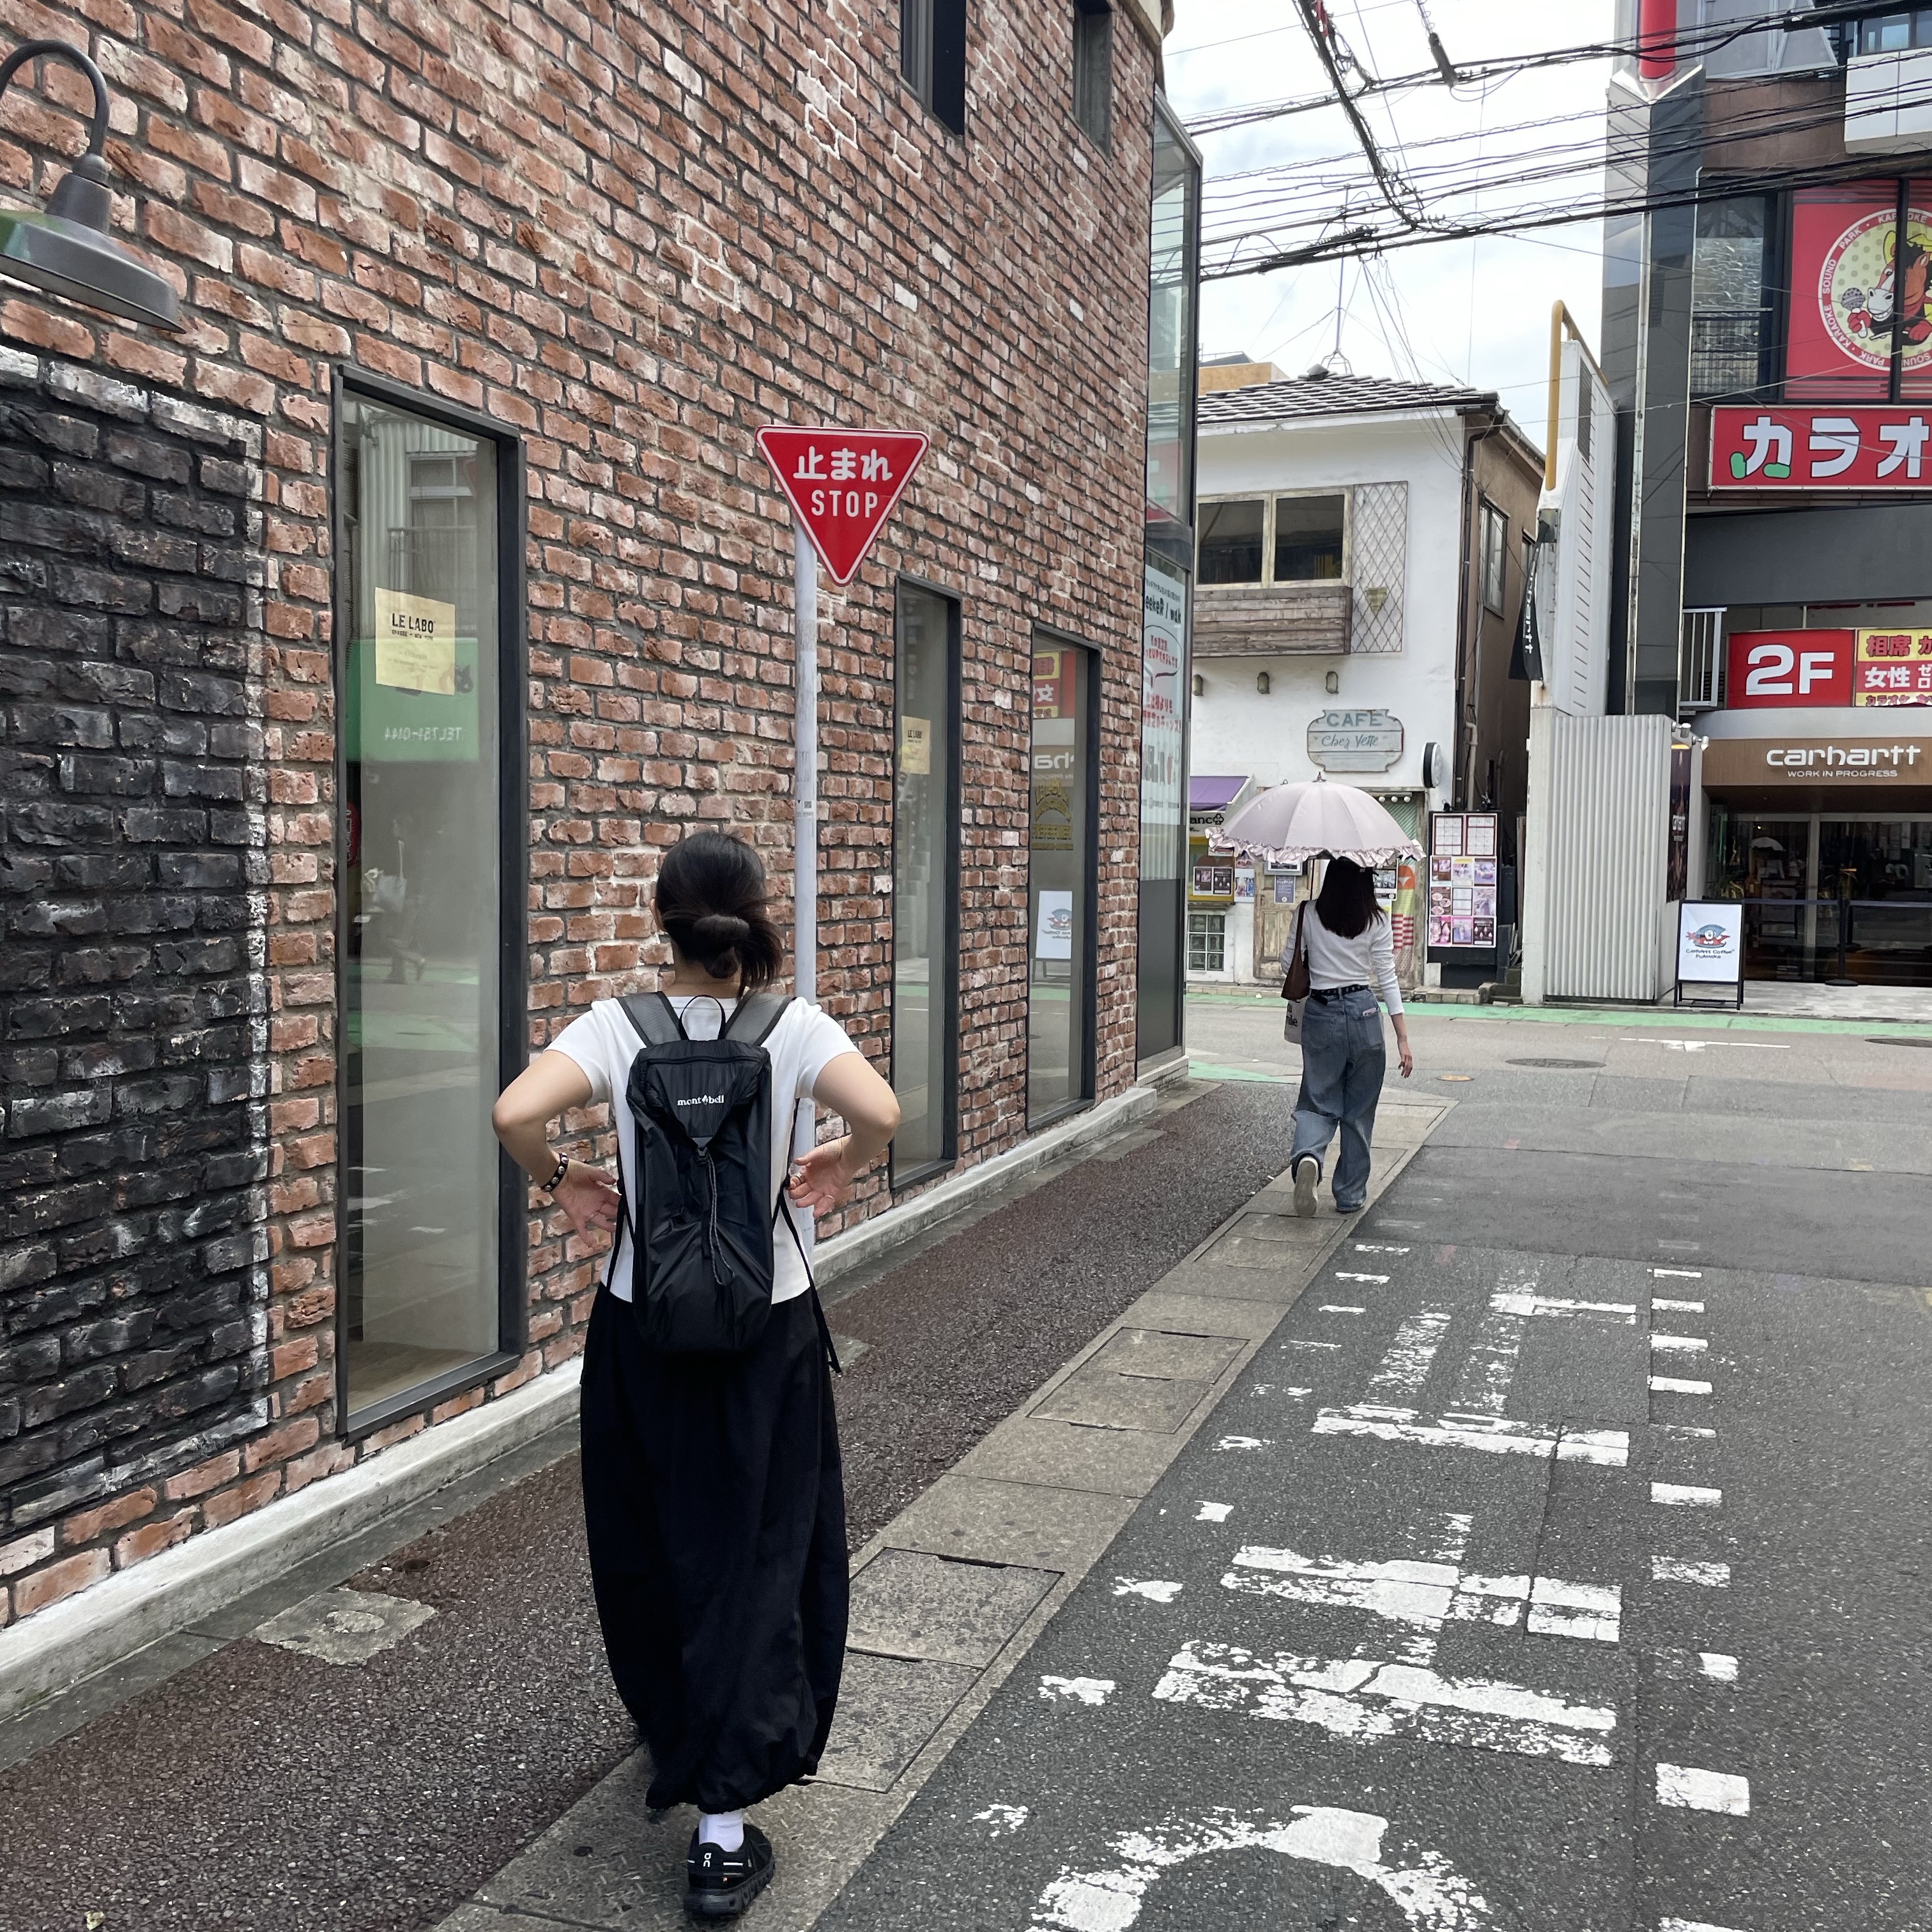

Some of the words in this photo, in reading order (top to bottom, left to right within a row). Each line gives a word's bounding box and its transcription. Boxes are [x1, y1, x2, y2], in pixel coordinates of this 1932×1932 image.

[1839, 227, 1862, 249] PARK
[1822, 259, 1837, 295] SOUND
[1824, 303, 1853, 348] KARAOKE
[1859, 351, 1885, 366] PARK
[1901, 352, 1931, 367] SOUN
[1730, 416, 1929, 479] カラオ
[793, 446, 893, 482] 止まれ
[811, 489, 878, 518] STOP
[392, 613, 406, 628] LE
[409, 616, 434, 633] LABO
[1866, 635, 1912, 657] 相席
[1745, 644, 1835, 696] 2F
[1864, 666, 1911, 689] 女性
[1326, 712, 1384, 727] CAFE
[1321, 733, 1350, 750] Chez
[1766, 745, 1921, 766] carhartt
